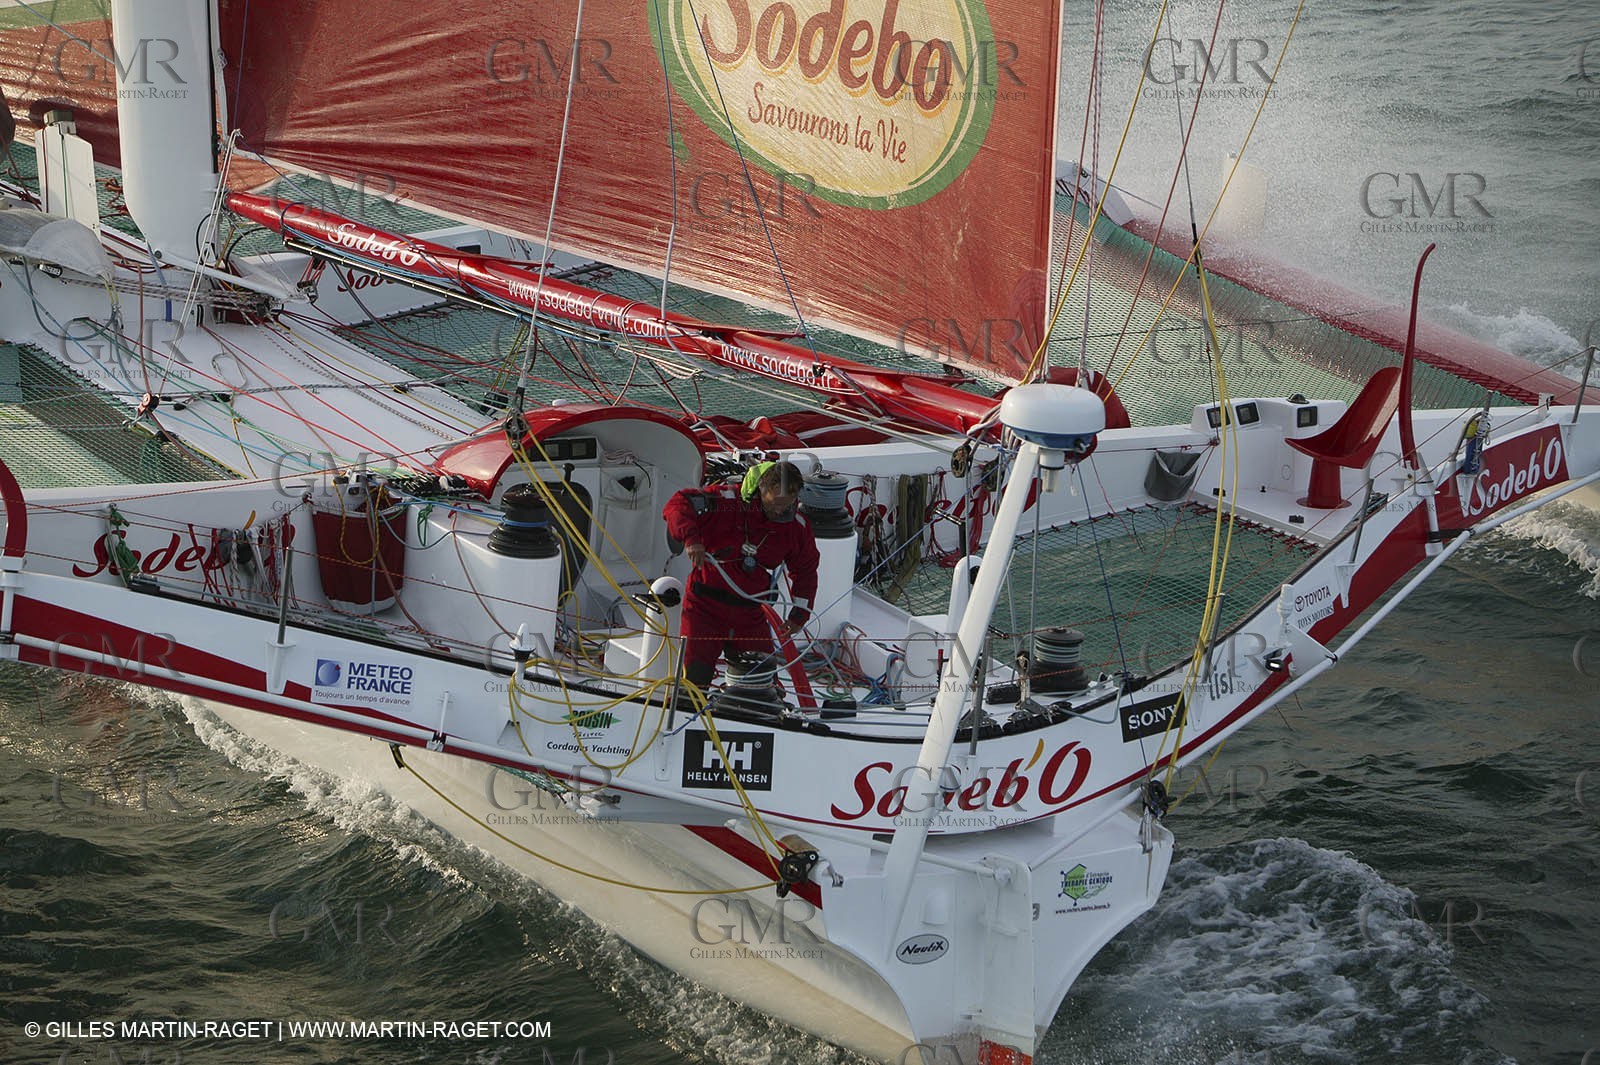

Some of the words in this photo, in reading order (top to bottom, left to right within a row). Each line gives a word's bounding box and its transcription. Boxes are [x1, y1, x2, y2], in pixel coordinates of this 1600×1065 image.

[748, 81, 848, 146] Savourons
[854, 116, 874, 153] la
[877, 118, 907, 164] Vie
[1304, 585, 1331, 607] TOYOTA
[348, 662, 413, 680] METEO
[347, 676, 412, 695] FRANCE
[314, 689, 344, 700] Toujours
[355, 694, 377, 704] temps
[379, 695, 410, 705] d'avance
[592, 744, 631, 757] Yachting
[687, 771, 720, 781] HELLY
[723, 772, 768, 783] HNSEN
